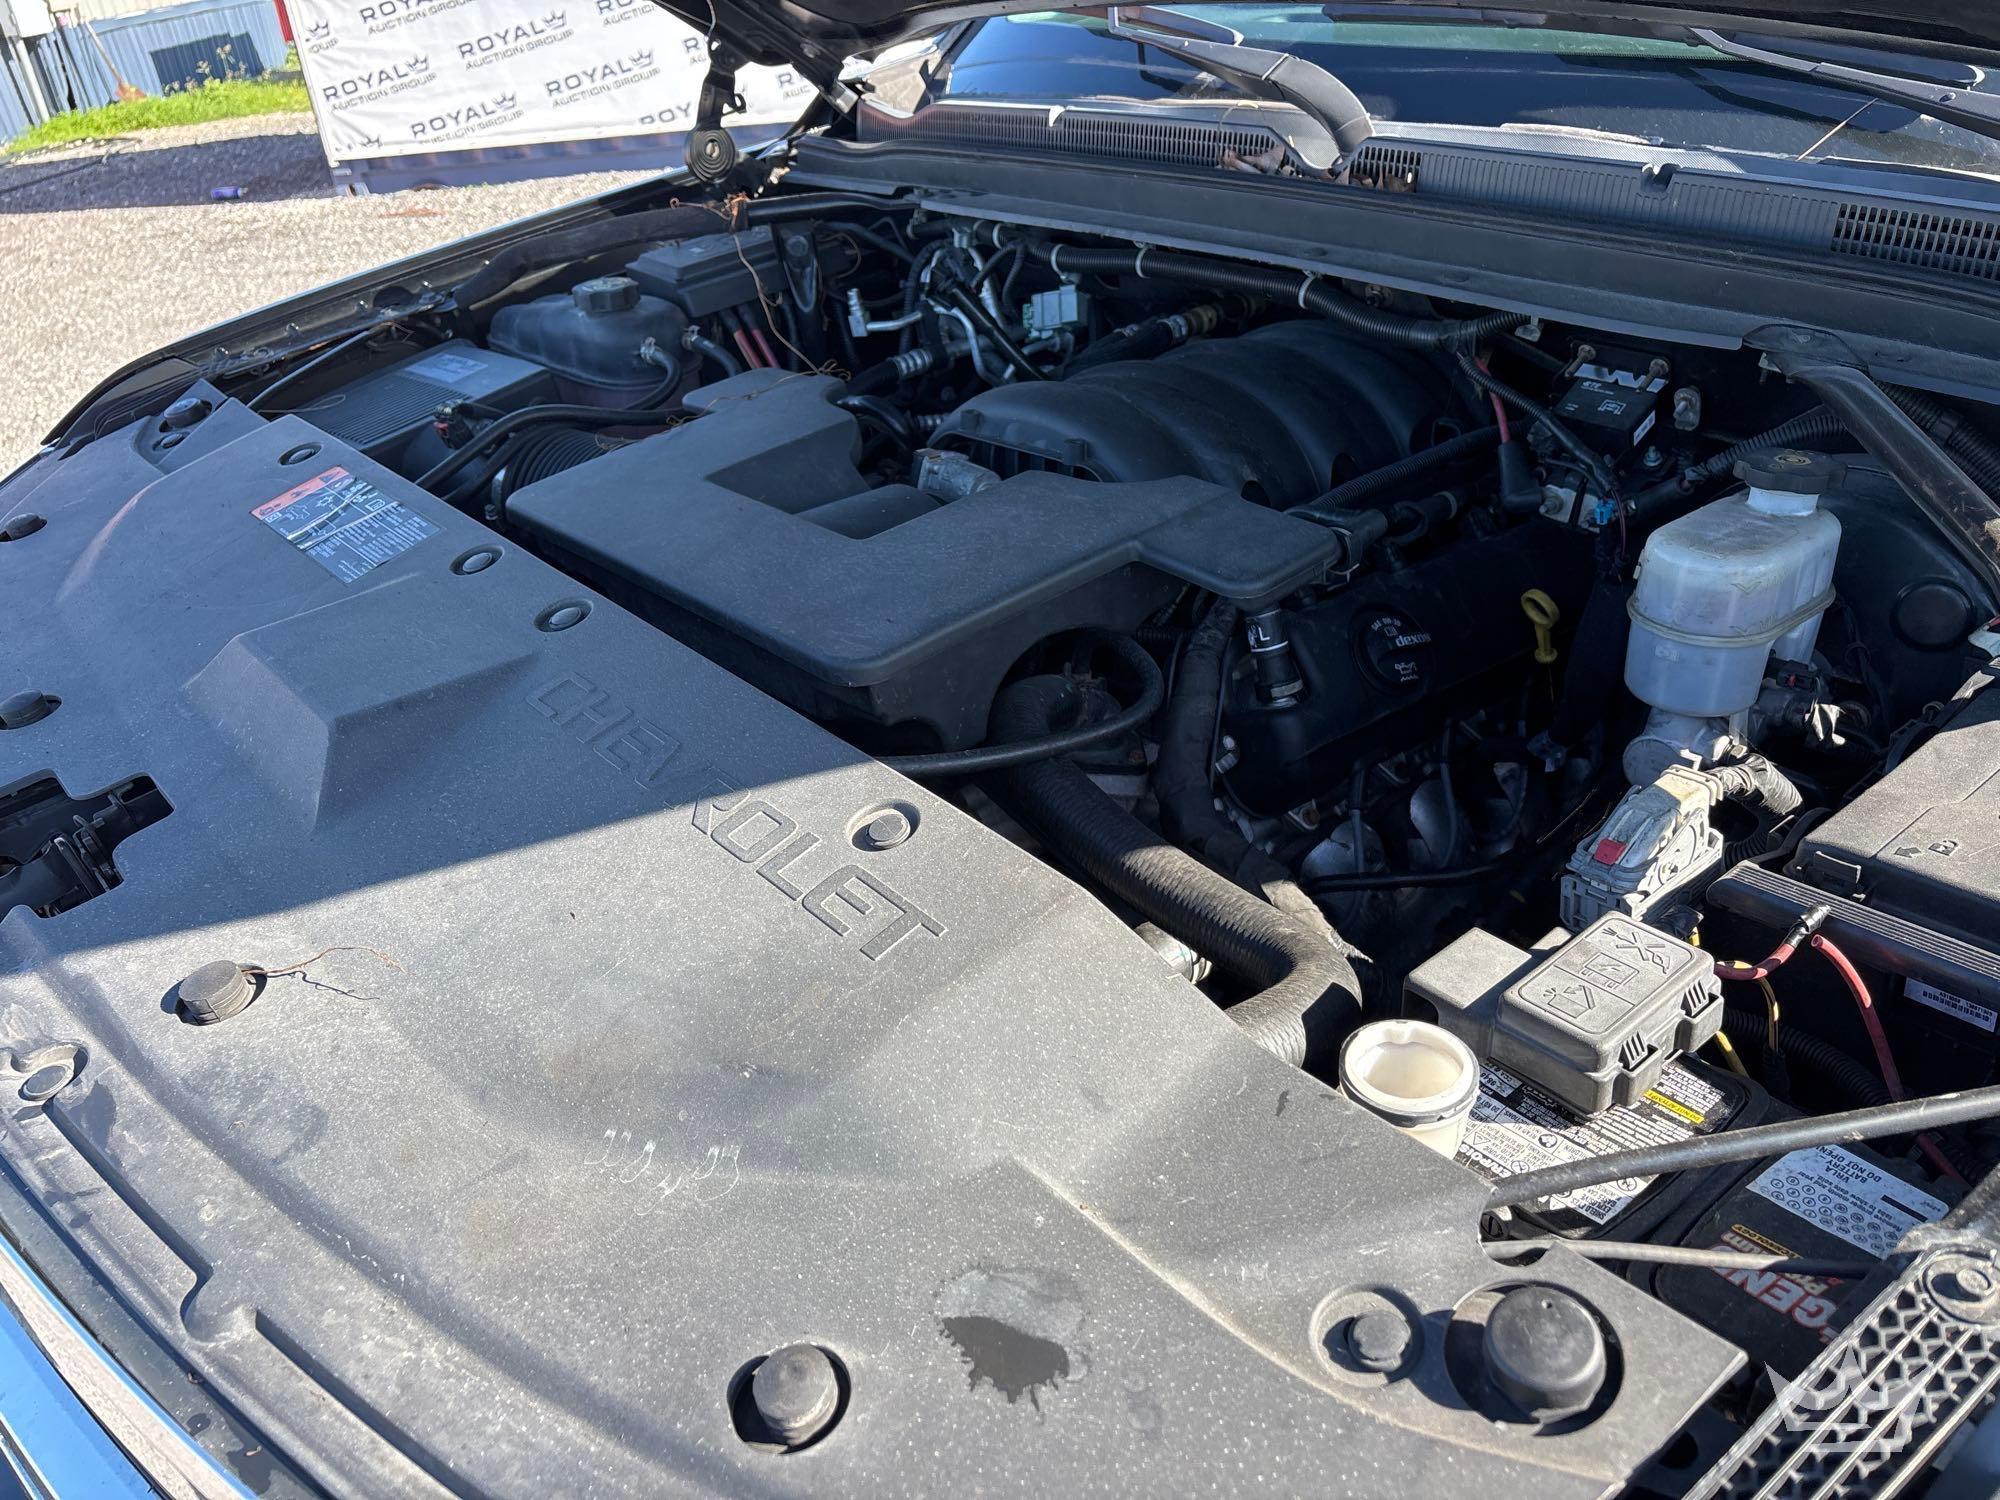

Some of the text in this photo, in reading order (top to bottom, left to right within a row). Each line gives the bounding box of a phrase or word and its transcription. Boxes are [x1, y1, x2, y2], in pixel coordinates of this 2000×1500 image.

[359, 0, 433, 23] ROY
[368, 0, 474, 37] AUCTION GROU
[603, 4, 657, 27] AUCTIO
[308, 37, 339, 54] OUP
[457, 20, 545, 59] ROYAL
[465, 28, 574, 71] AUCTION GROUP
[322, 63, 408, 102] ROYAL
[545, 58, 632, 97] ROYAL
[552, 67, 661, 108] AUCTION GROUP
[331, 71, 437, 112] AUCTION GROUP
[411, 102, 496, 139] ROYAL
[638, 102, 692, 125] ROY
[524, 671, 949, 961] CHEVROLET
[1480, 1099, 1492, 1108] NOT
[1823, 1164, 1850, 1183] VRLA
[1825, 1157, 1868, 1184] BATTERY
[1843, 1158, 1866, 1174] NOT
[1864, 1170, 1882, 1183] DO
[1579, 1192, 1612, 1213] EXPLOSIVE
[1584, 1204, 1606, 1220] SHIELD
